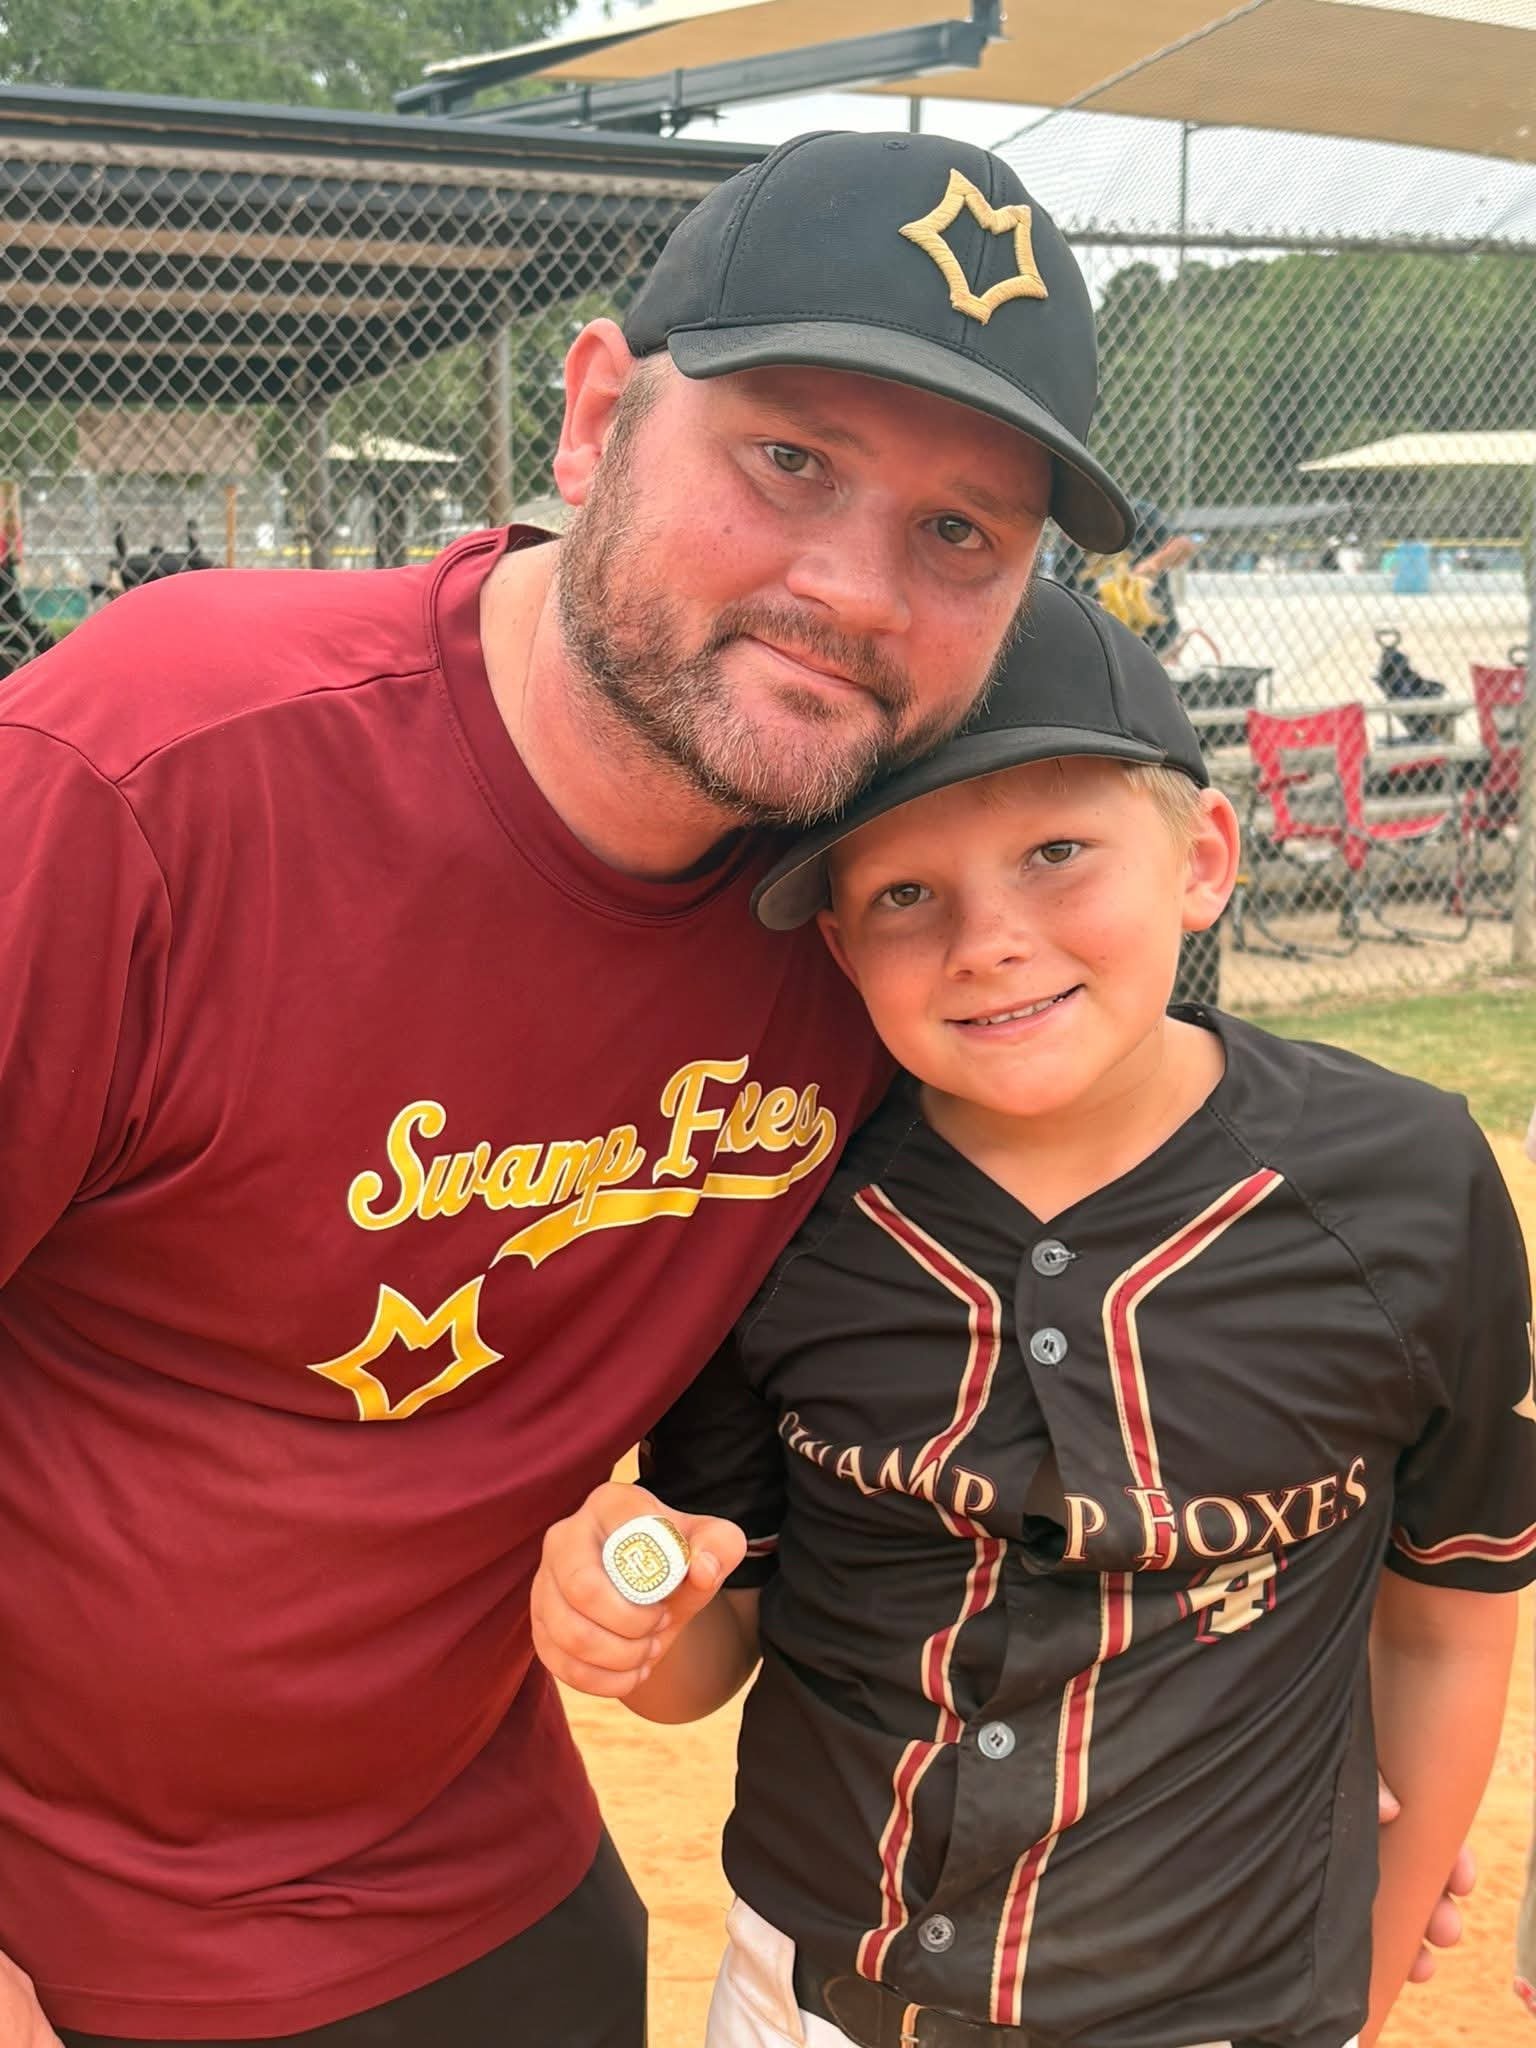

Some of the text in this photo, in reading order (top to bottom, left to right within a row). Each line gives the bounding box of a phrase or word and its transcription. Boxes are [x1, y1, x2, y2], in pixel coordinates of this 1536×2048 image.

[348, 1054, 837, 1230] Swamp Fxes
[1124, 1454, 1368, 1561] FOXES
[1176, 1550, 1288, 1646] 4
